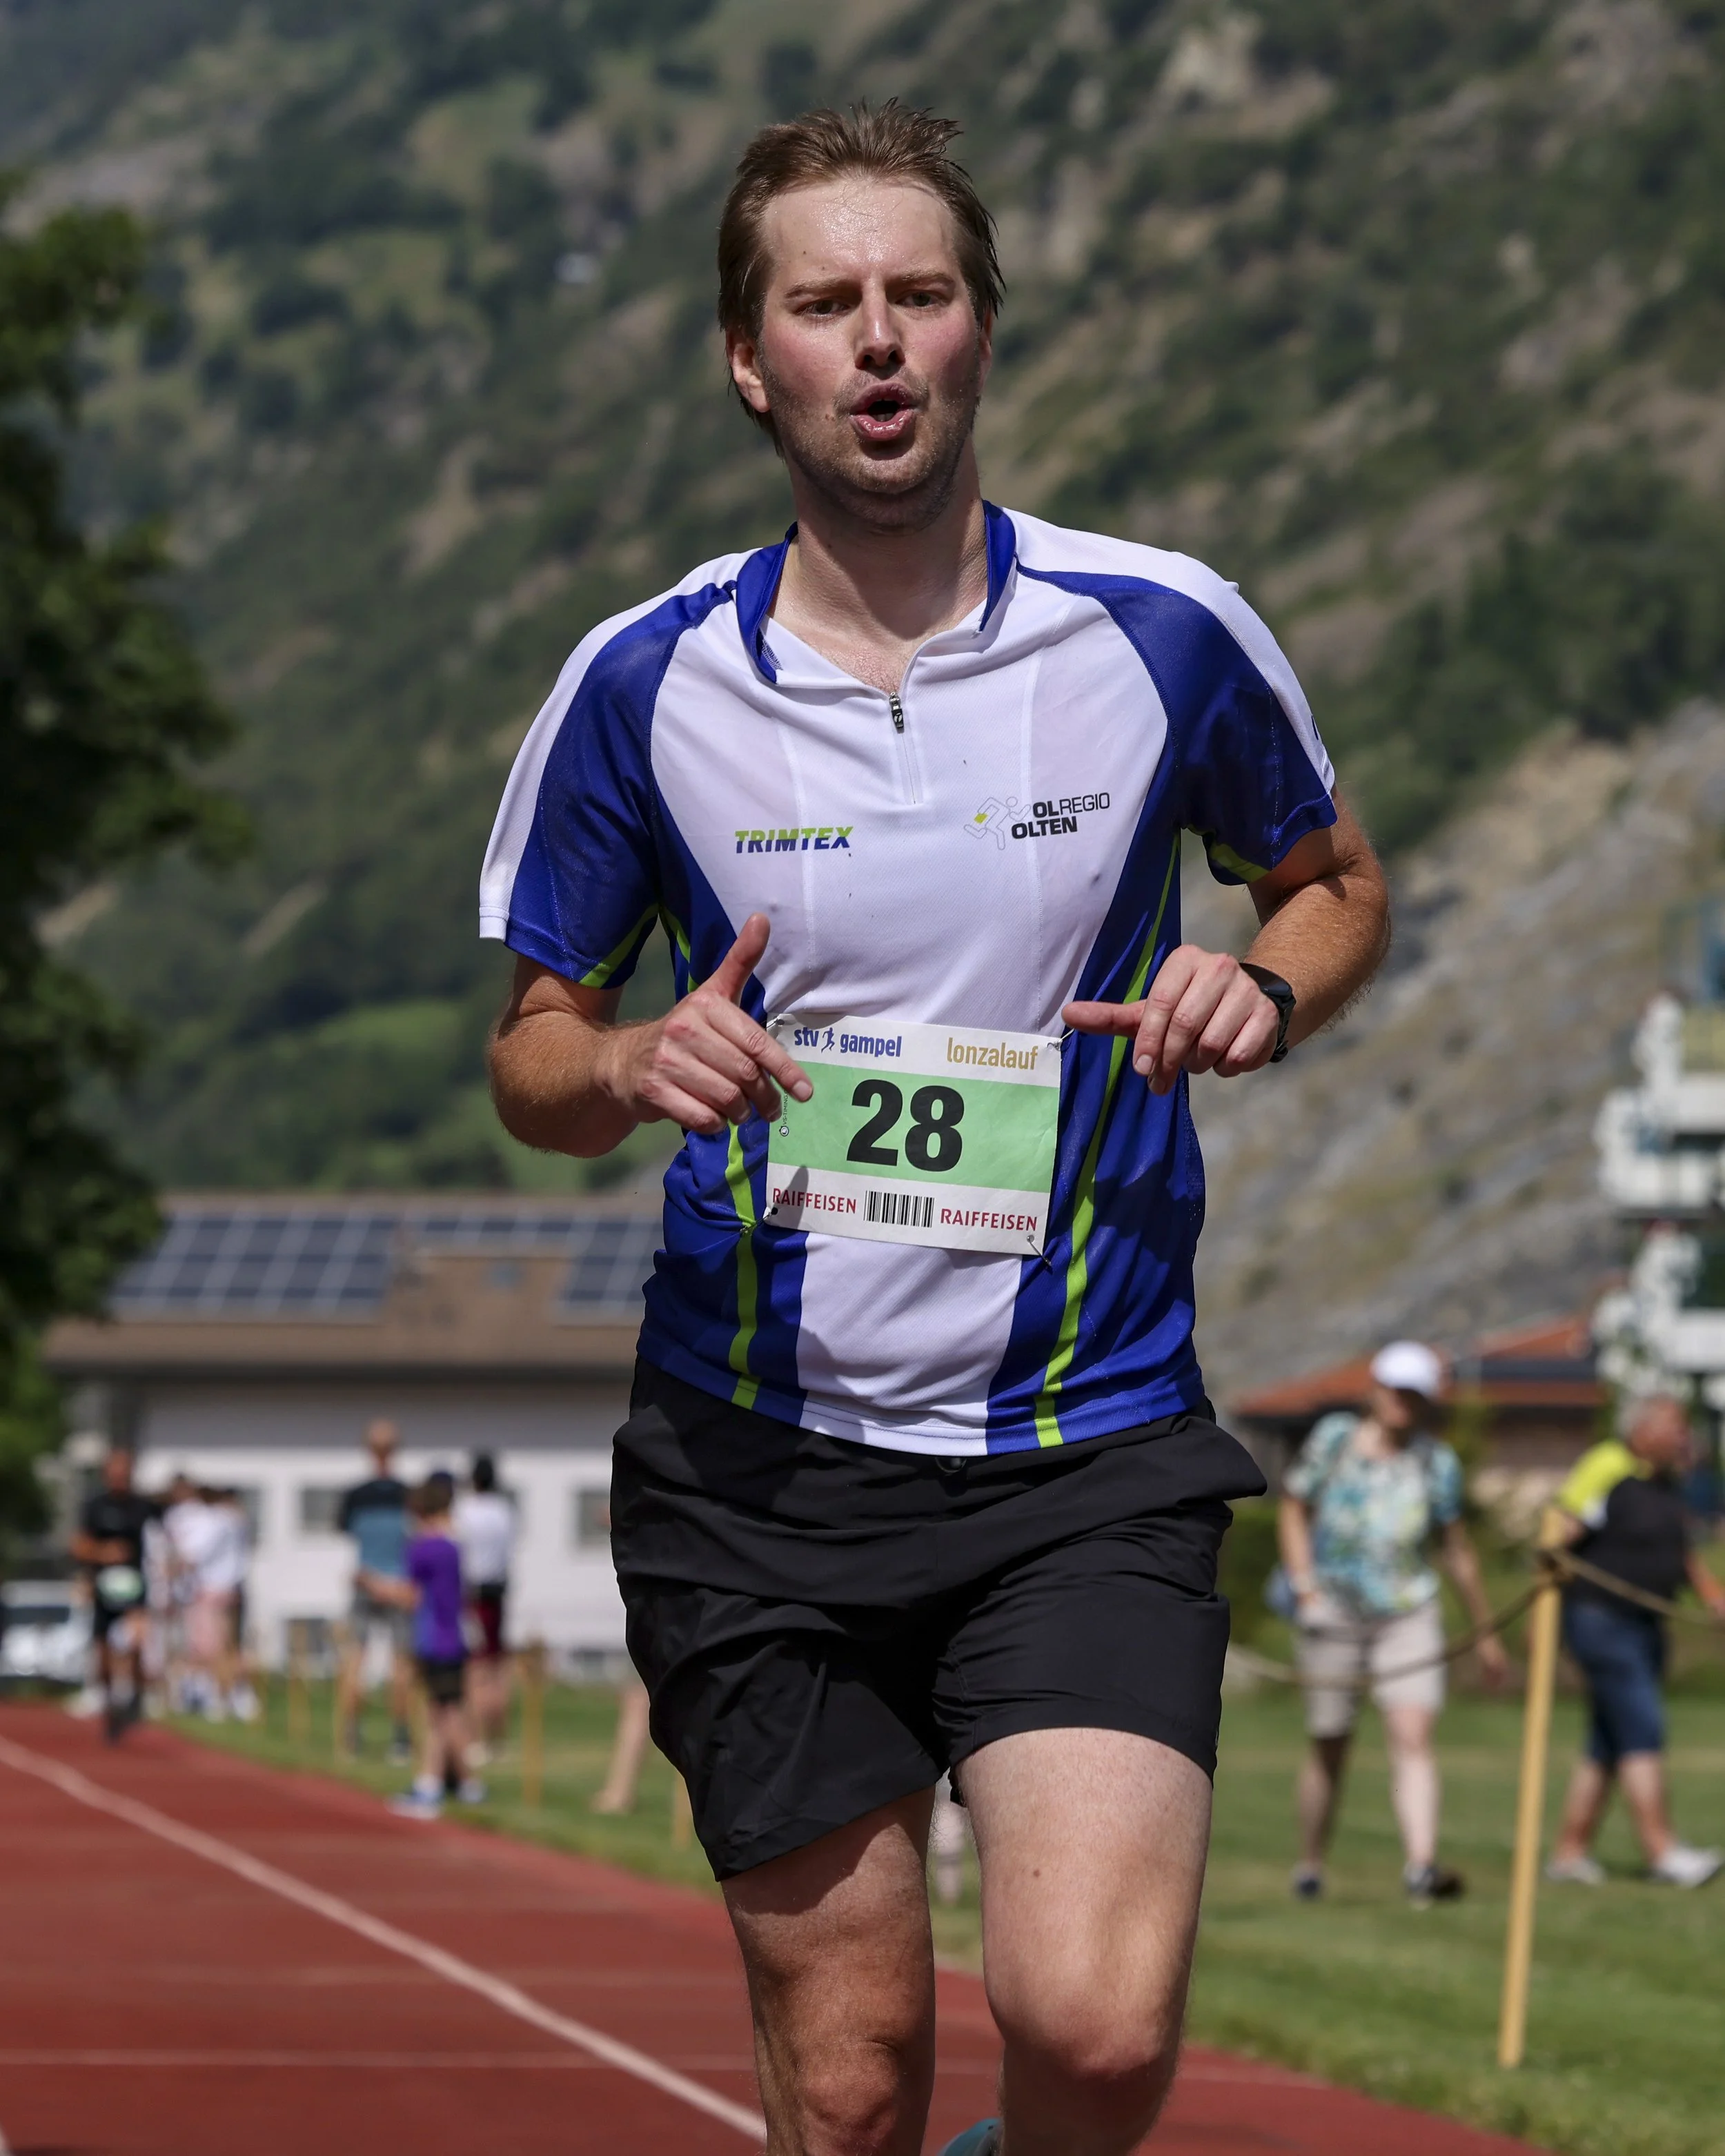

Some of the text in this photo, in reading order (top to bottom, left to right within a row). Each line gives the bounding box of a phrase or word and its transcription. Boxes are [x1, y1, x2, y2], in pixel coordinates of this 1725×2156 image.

[735, 827, 854, 853] TRIMTEX
[1011, 815, 1078, 840] OLTEN
[793, 1027, 903, 1058] stv gampel
[947, 1037, 1038, 1070] lonzalauf
[846, 1078, 965, 1172] 28
[772, 1188, 857, 1214] RAIFFEISEN
[940, 1208, 1038, 1232] RAIFFEISEN
